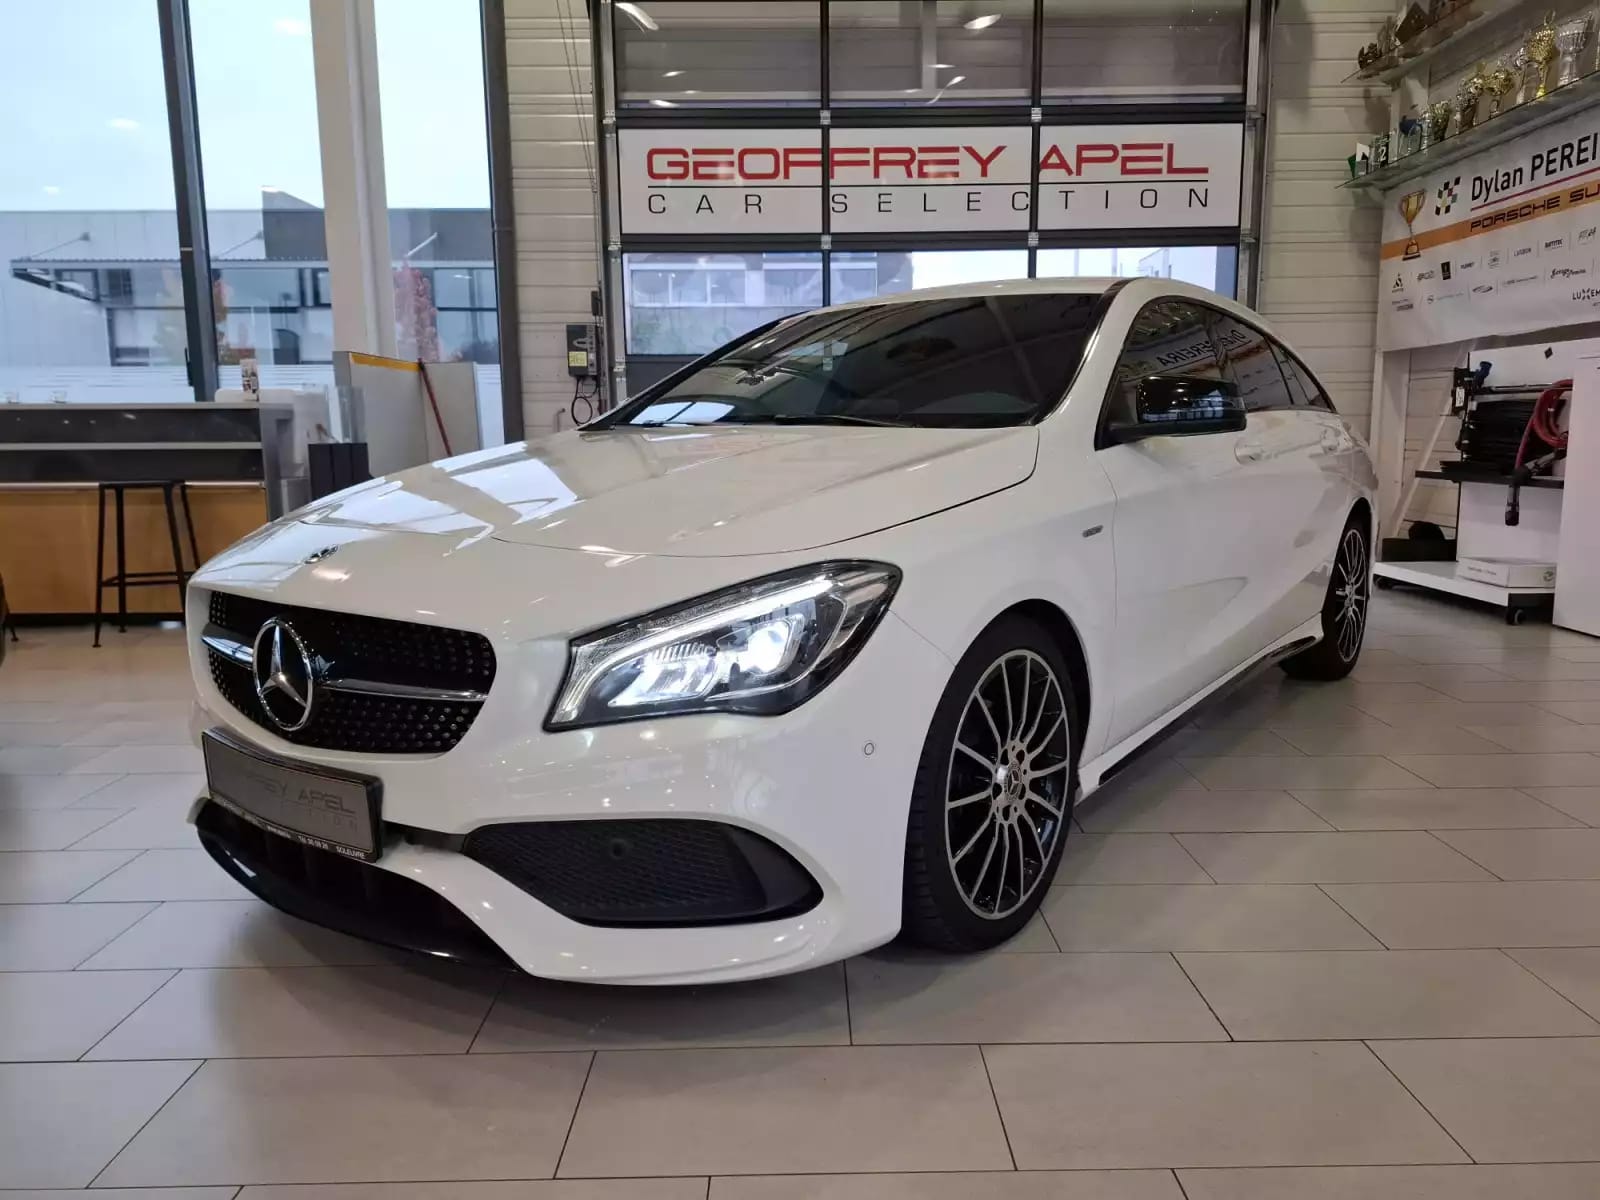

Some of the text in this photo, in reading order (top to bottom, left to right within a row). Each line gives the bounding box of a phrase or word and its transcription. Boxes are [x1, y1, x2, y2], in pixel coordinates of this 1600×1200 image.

[646, 143, 1209, 180] GEOFFREY APEL
[1471, 132, 1599, 203] Dylan PEREI
[648, 188, 1209, 214] CAR SELECTION
[1470, 195, 1561, 232] PORSCHE
